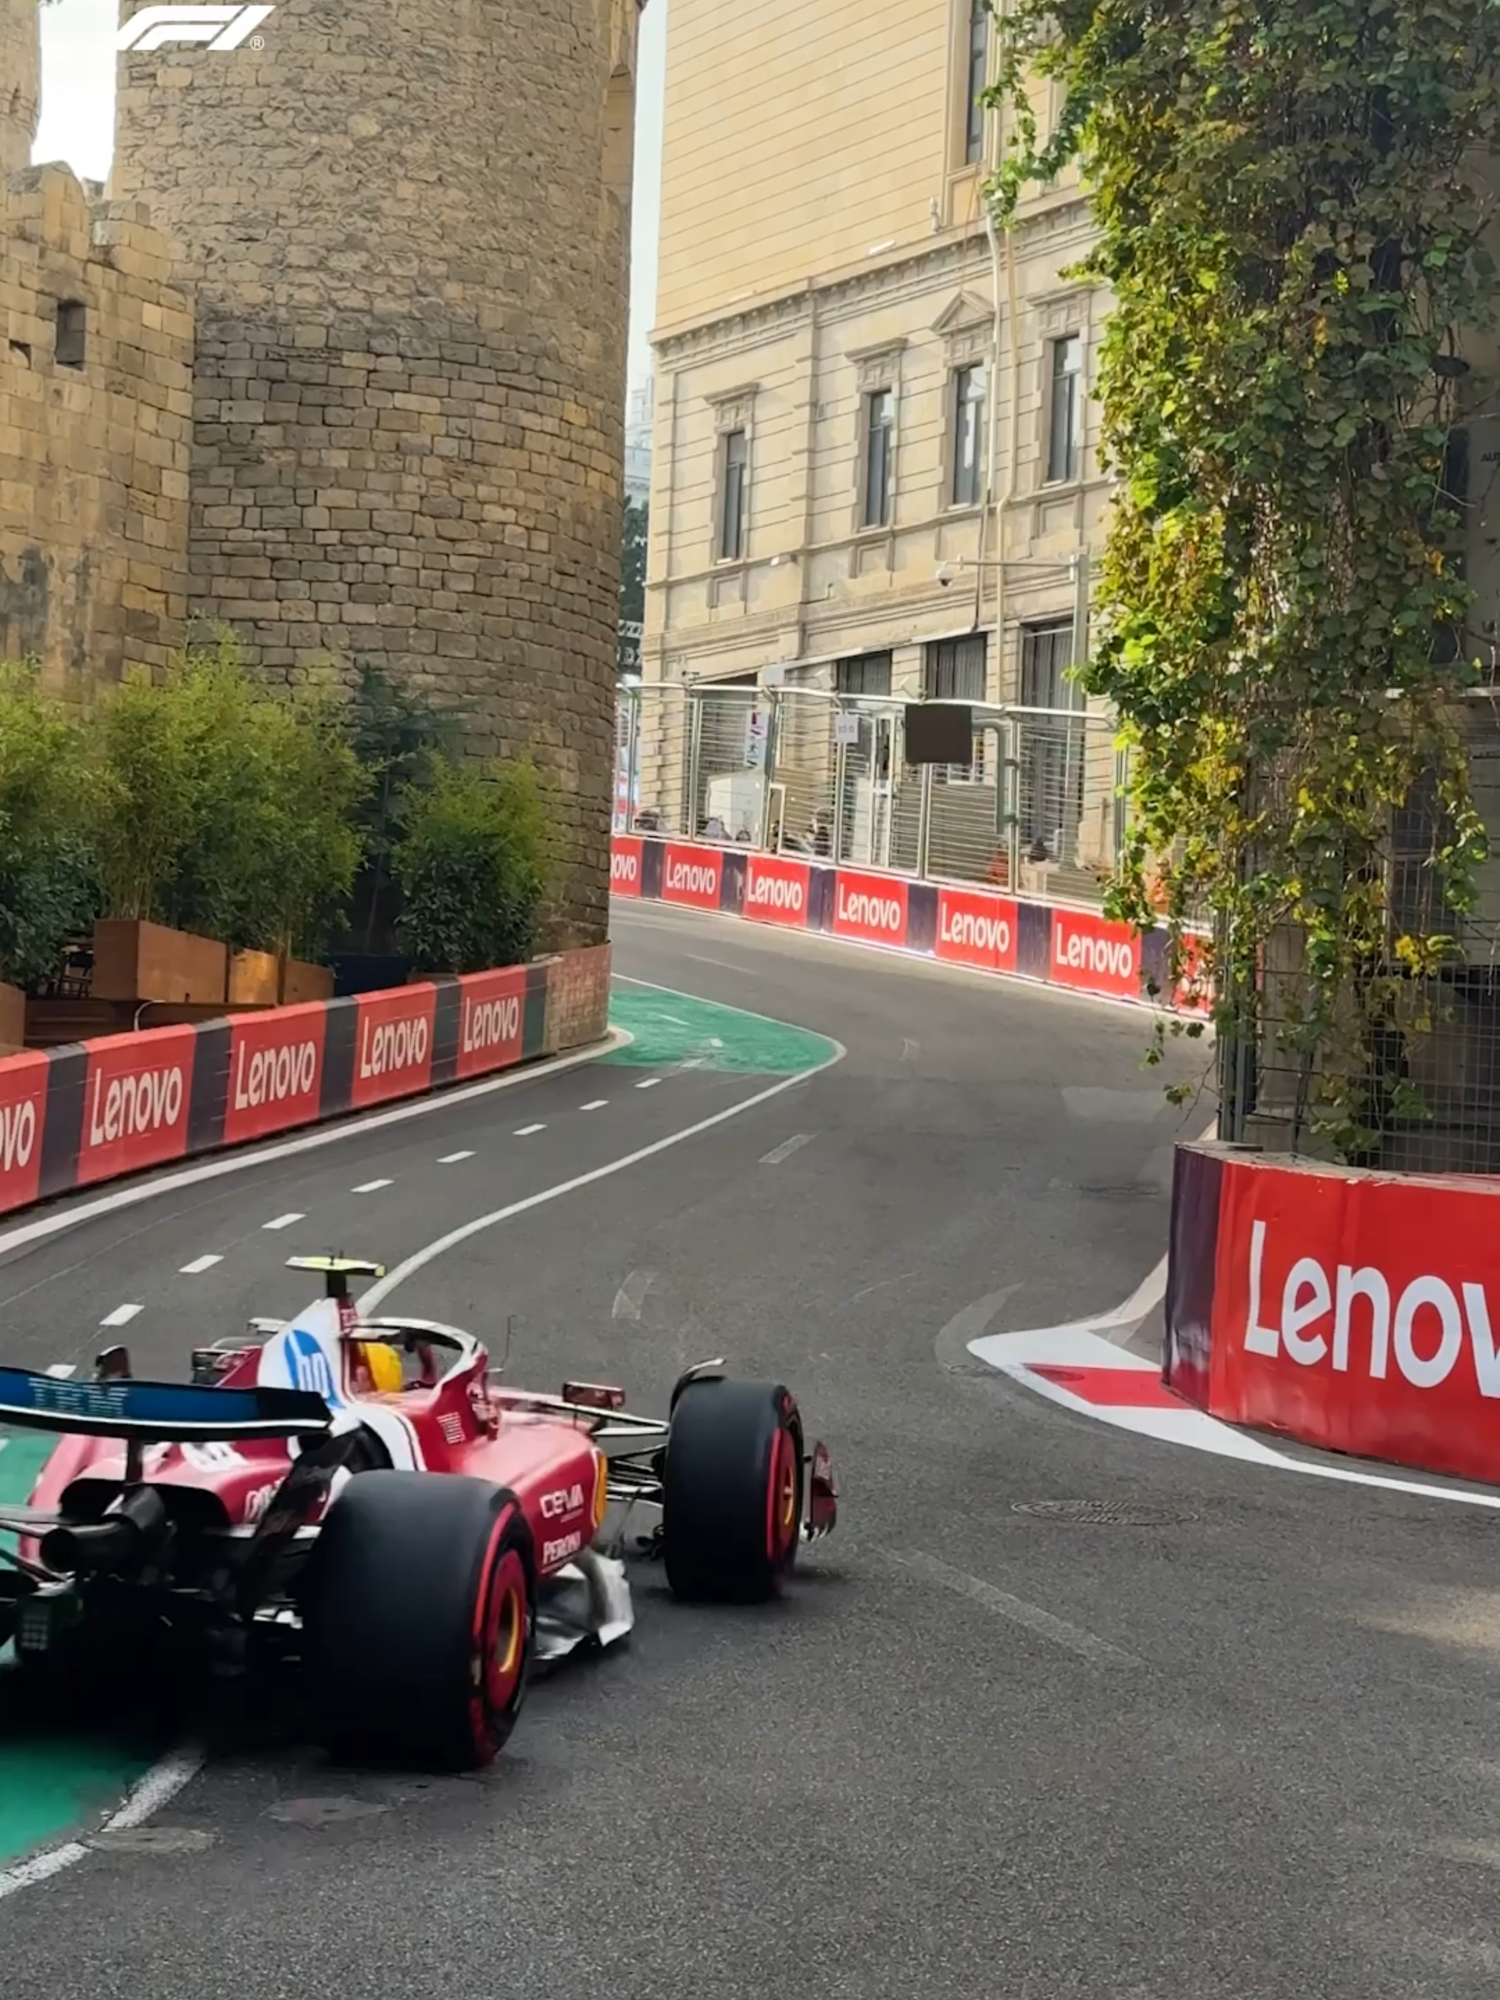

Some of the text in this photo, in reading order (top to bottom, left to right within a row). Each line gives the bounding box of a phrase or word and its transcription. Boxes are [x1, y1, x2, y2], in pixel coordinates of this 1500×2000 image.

[666, 854, 716, 894] Lenovo
[748, 866, 803, 910] Lenovo
[838, 883, 900, 931] Lenovo
[941, 903, 1010, 953] Lenovo
[1056, 923, 1133, 978] Lenovo
[360, 1016, 428, 1079] Lenovo
[463, 996, 519, 1053] Lenovo
[235, 1040, 317, 1110] Lenovo
[90, 1067, 182, 1146] Lenovo
[0, 1100, 35, 1171] vo
